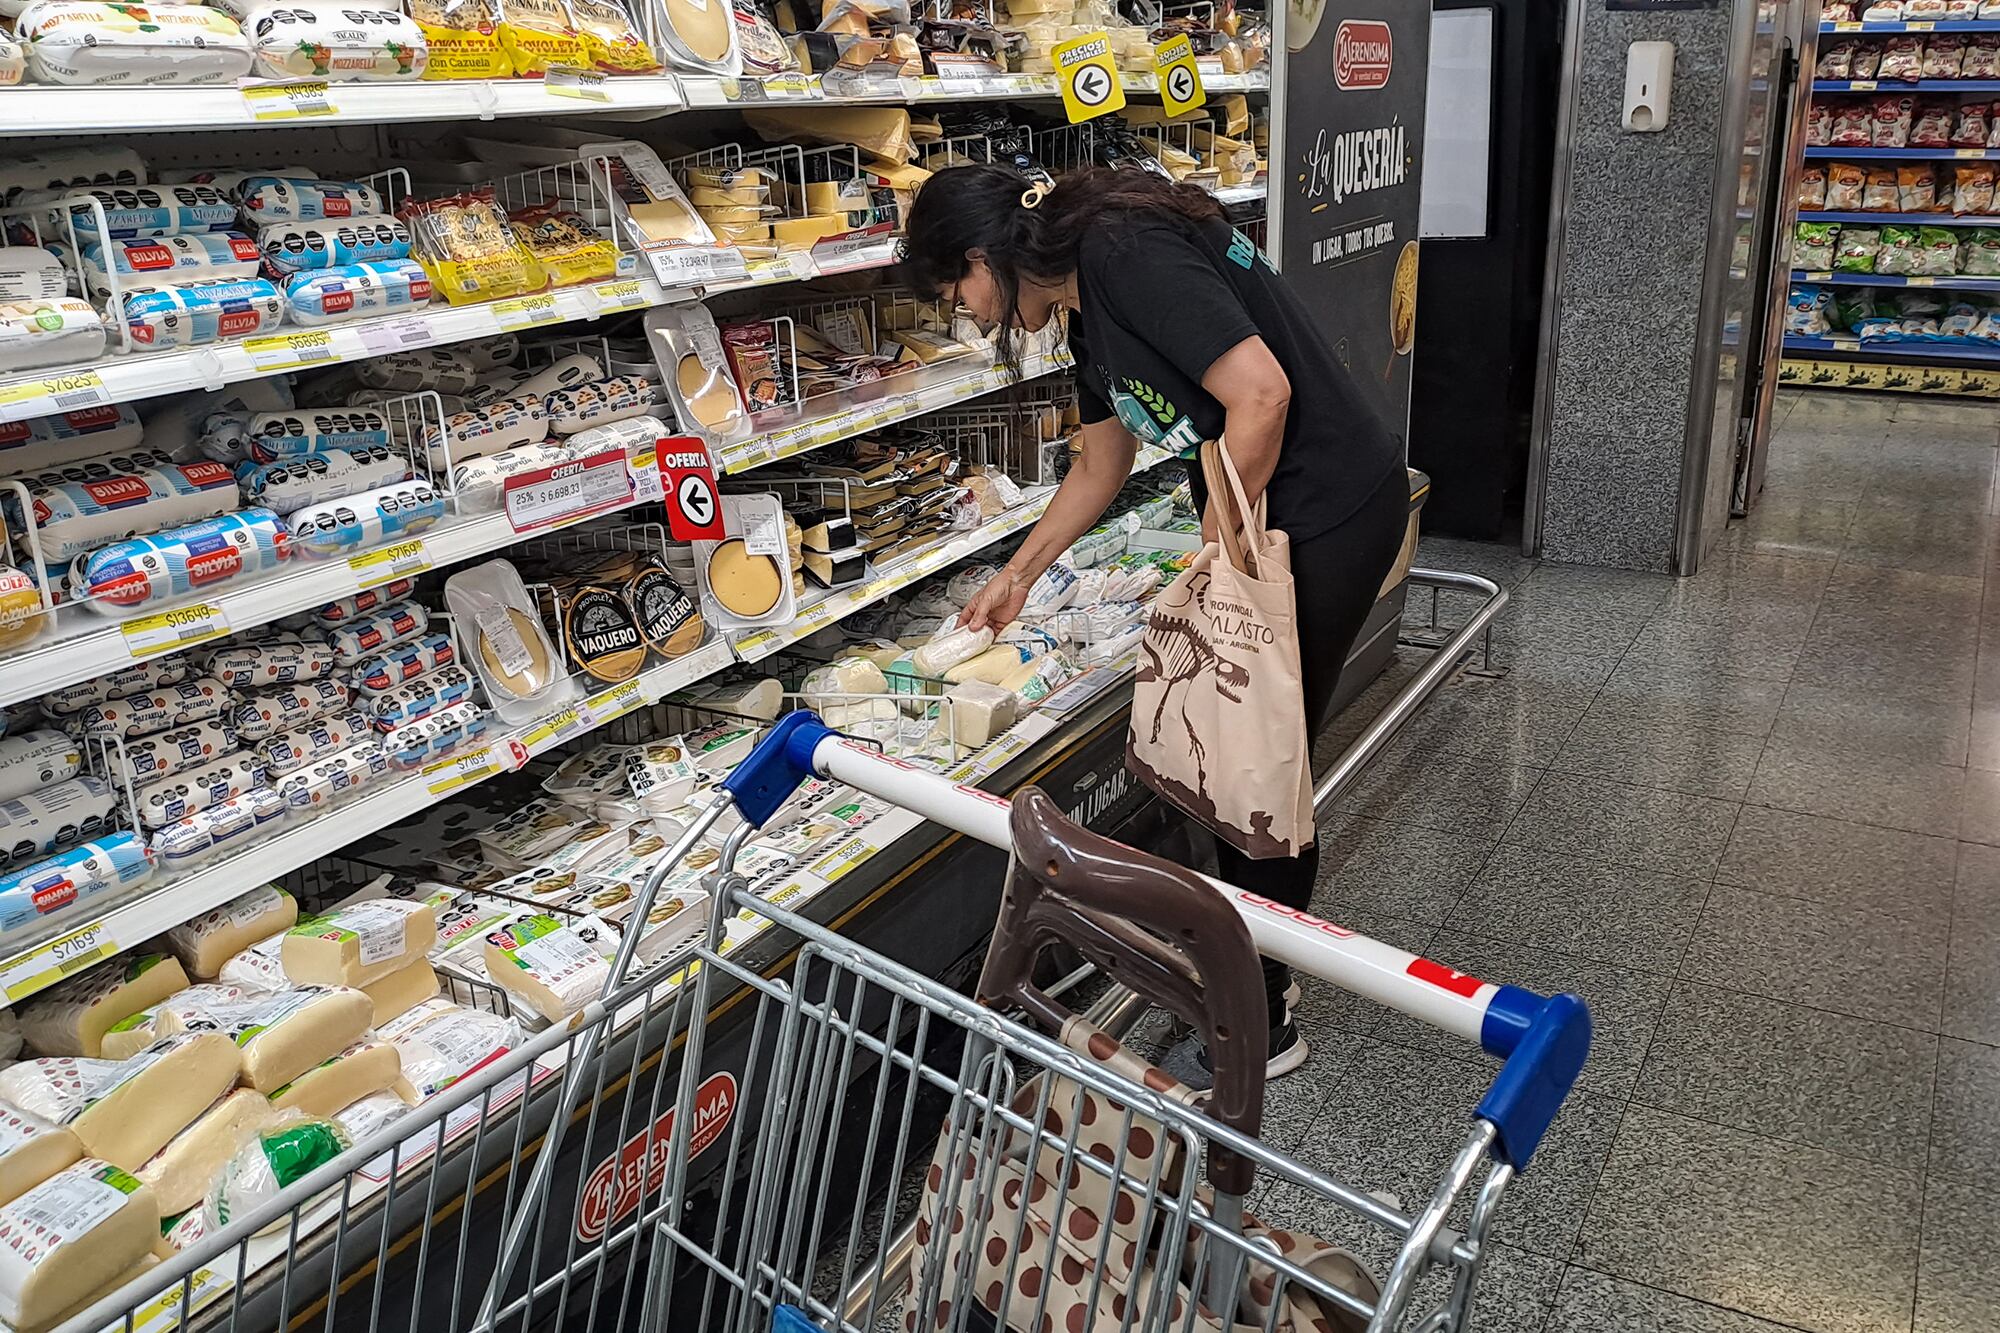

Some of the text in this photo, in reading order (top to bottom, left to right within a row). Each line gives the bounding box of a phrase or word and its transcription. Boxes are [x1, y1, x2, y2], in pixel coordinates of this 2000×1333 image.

[333, 58, 377, 70] MOZZARELLA
[429, 58, 490, 68] Con Cazuela
[1308, 113, 1405, 205] La QUESERÍA
[325, 201, 350, 213] SILVIA
[1312, 241, 1322, 264] UN
[1323, 235, 1344, 261] LUGAR,
[1345, 229, 1362, 252] TODOS
[1363, 226, 1374, 248] TUS
[131, 250, 169, 264] SILVIA
[326, 294, 352, 307] SILVIA
[222, 316, 256, 331] SILVIA
[665, 452, 709, 469] OFERTA
[187, 463, 228, 480] SILVIA
[550, 462, 586, 481] OFERTA
[93, 481, 142, 498] SILVIA
[516, 491, 534, 506] 25%
[193, 556, 237, 579] SILVIA
[636, 573, 663, 602] PROVOLETA
[578, 592, 614, 612] PROVOLETA
[166, 605, 211, 629] $13649
[648, 596, 692, 640] VAQUERO
[579, 626, 637, 656] VAQUERO
[114, 672, 149, 688] MOZZARELLA
[61, 686, 98, 702] MOZZARELLA
[182, 698, 214, 712] MOZZARELLA
[133, 709, 167, 724] MOZZARELLA
[1086, 767, 1128, 827] LUGAR,
[52, 934, 95, 960] $7169
